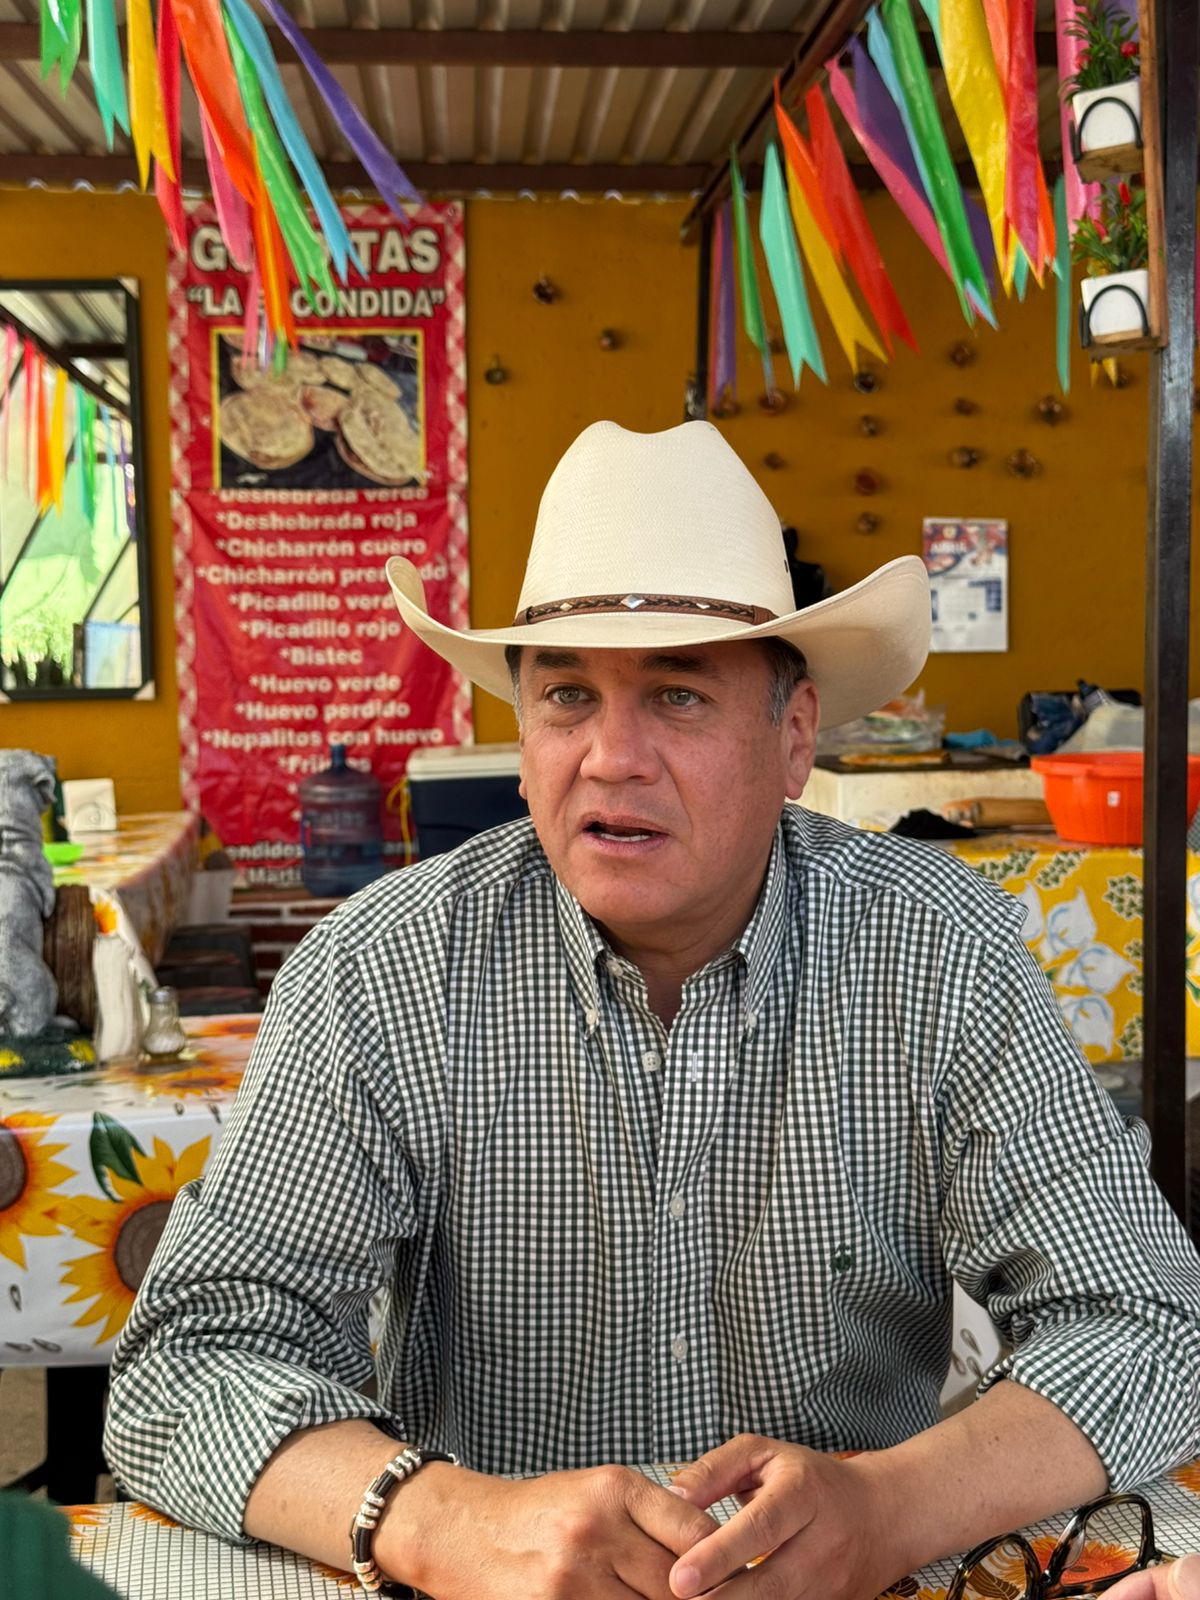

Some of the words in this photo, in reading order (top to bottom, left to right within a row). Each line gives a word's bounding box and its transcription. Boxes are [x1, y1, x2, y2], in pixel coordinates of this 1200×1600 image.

[190, 226, 441, 273] GTAS
[258, 288, 445, 318] CONDIDA”
[371, 509, 417, 531] roja
[360, 537, 427, 555] cuero
[340, 564, 447, 587] predo
[346, 593, 397, 611] verd
[355, 618, 401, 640] rojo
[337, 674, 402, 692] verde
[323, 700, 411, 723] perdido
[328, 730, 370, 746] con
[375, 726, 445, 744] huevo
